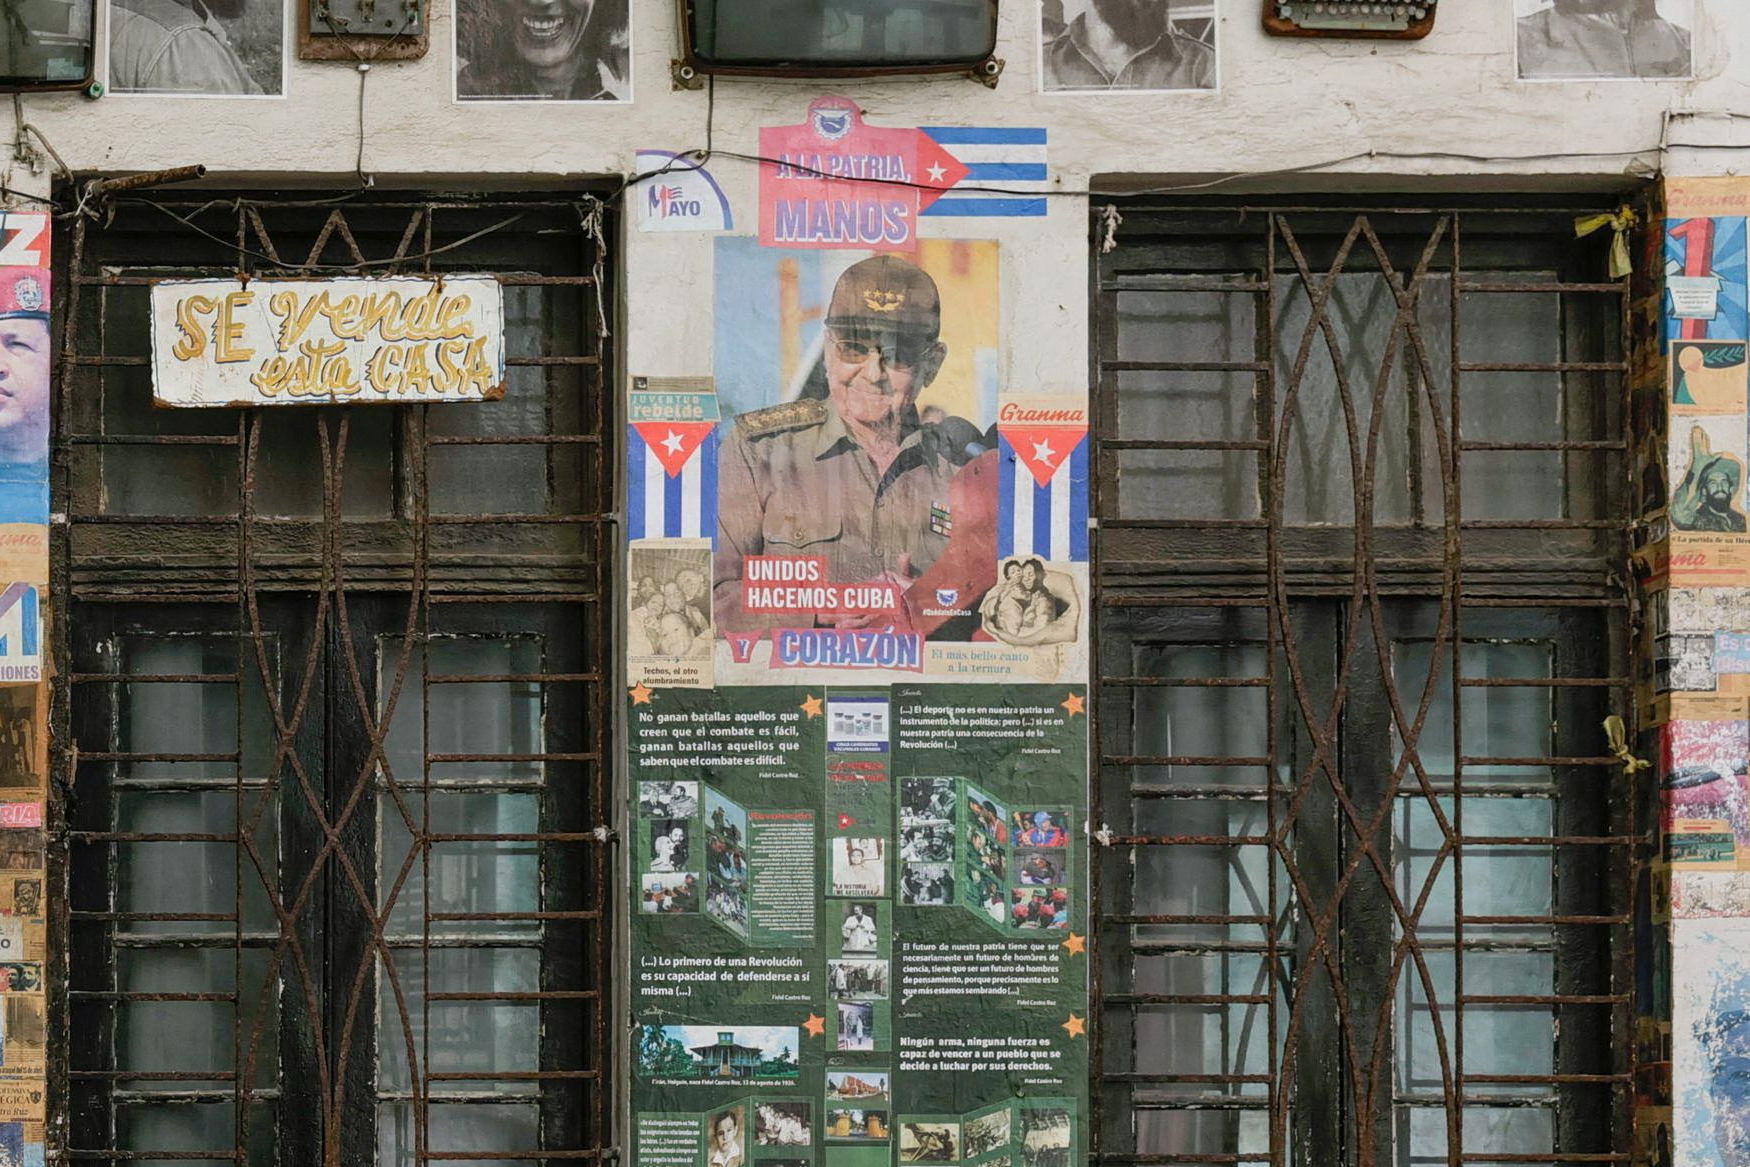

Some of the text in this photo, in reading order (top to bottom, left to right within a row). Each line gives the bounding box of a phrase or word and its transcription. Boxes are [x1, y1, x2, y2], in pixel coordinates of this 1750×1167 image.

[777, 154, 791, 178] A
[794, 154, 823, 179] LA
[774, 199, 910, 244] MANOS
[173, 292, 256, 362] SE
[365, 336, 492, 398] CASA
[634, 403, 703, 419] rebelde
[1000, 403, 1084, 424] Granma
[748, 560, 819, 581] UNIDOS
[748, 586, 894, 609] HACEMOS CUBA
[779, 625, 921, 667] CORAZÓN
[639, 711, 798, 724] No ganan batallas aquellos que
